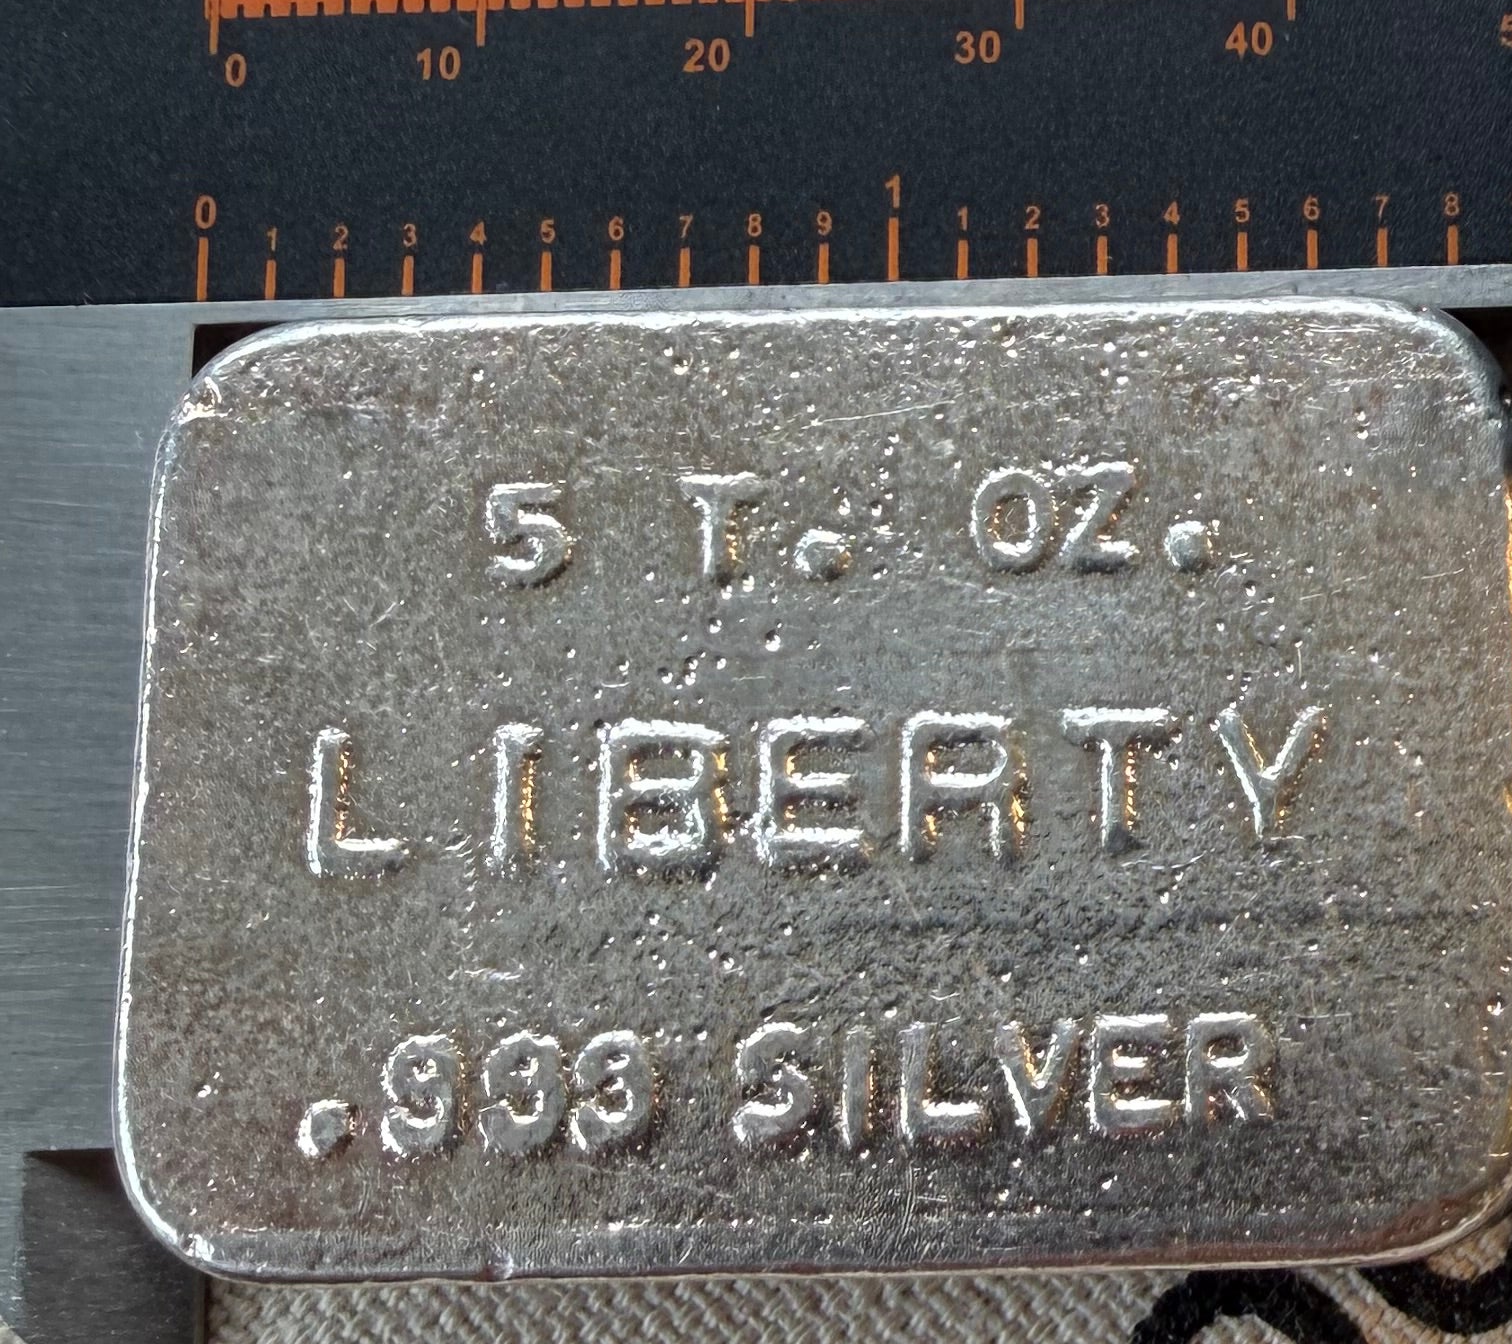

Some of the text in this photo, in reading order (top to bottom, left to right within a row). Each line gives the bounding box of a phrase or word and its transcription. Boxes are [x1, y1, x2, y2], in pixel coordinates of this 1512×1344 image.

[223, 52, 248, 88] 0
[417, 45, 462, 82] 10
[682, 37, 732, 73] 20
[954, 30, 1001, 65] 30
[1225, 20, 1274, 57] 40
[193, 194, 218, 230] 0
[266, 227, 280, 252] 1
[333, 225, 350, 250] 2
[402, 223, 418, 249] 3
[469, 221, 488, 246] 4
[539, 218, 556, 244] 5
[607, 216, 625, 242] 6
[679, 214, 694, 240] 7
[746, 212, 763, 238] 8
[816, 210, 833, 237] 9
[884, 173, 902, 210] 1
[957, 207, 970, 232] 1
[1024, 205, 1041, 230] 2
[1095, 203, 1111, 229] 3
[1163, 201, 1181, 226] 4
[1233, 199, 1251, 224] 5
[1303, 196, 1320, 221] 6
[1375, 194, 1390, 219] 7
[1443, 192, 1461, 217] 8
[484, 479, 574, 588] 5
[969, 459, 1221, 578] OZ.
[304, 702, 1331, 880] LIBERTY
[731, 1011, 1280, 1152] SILVER
